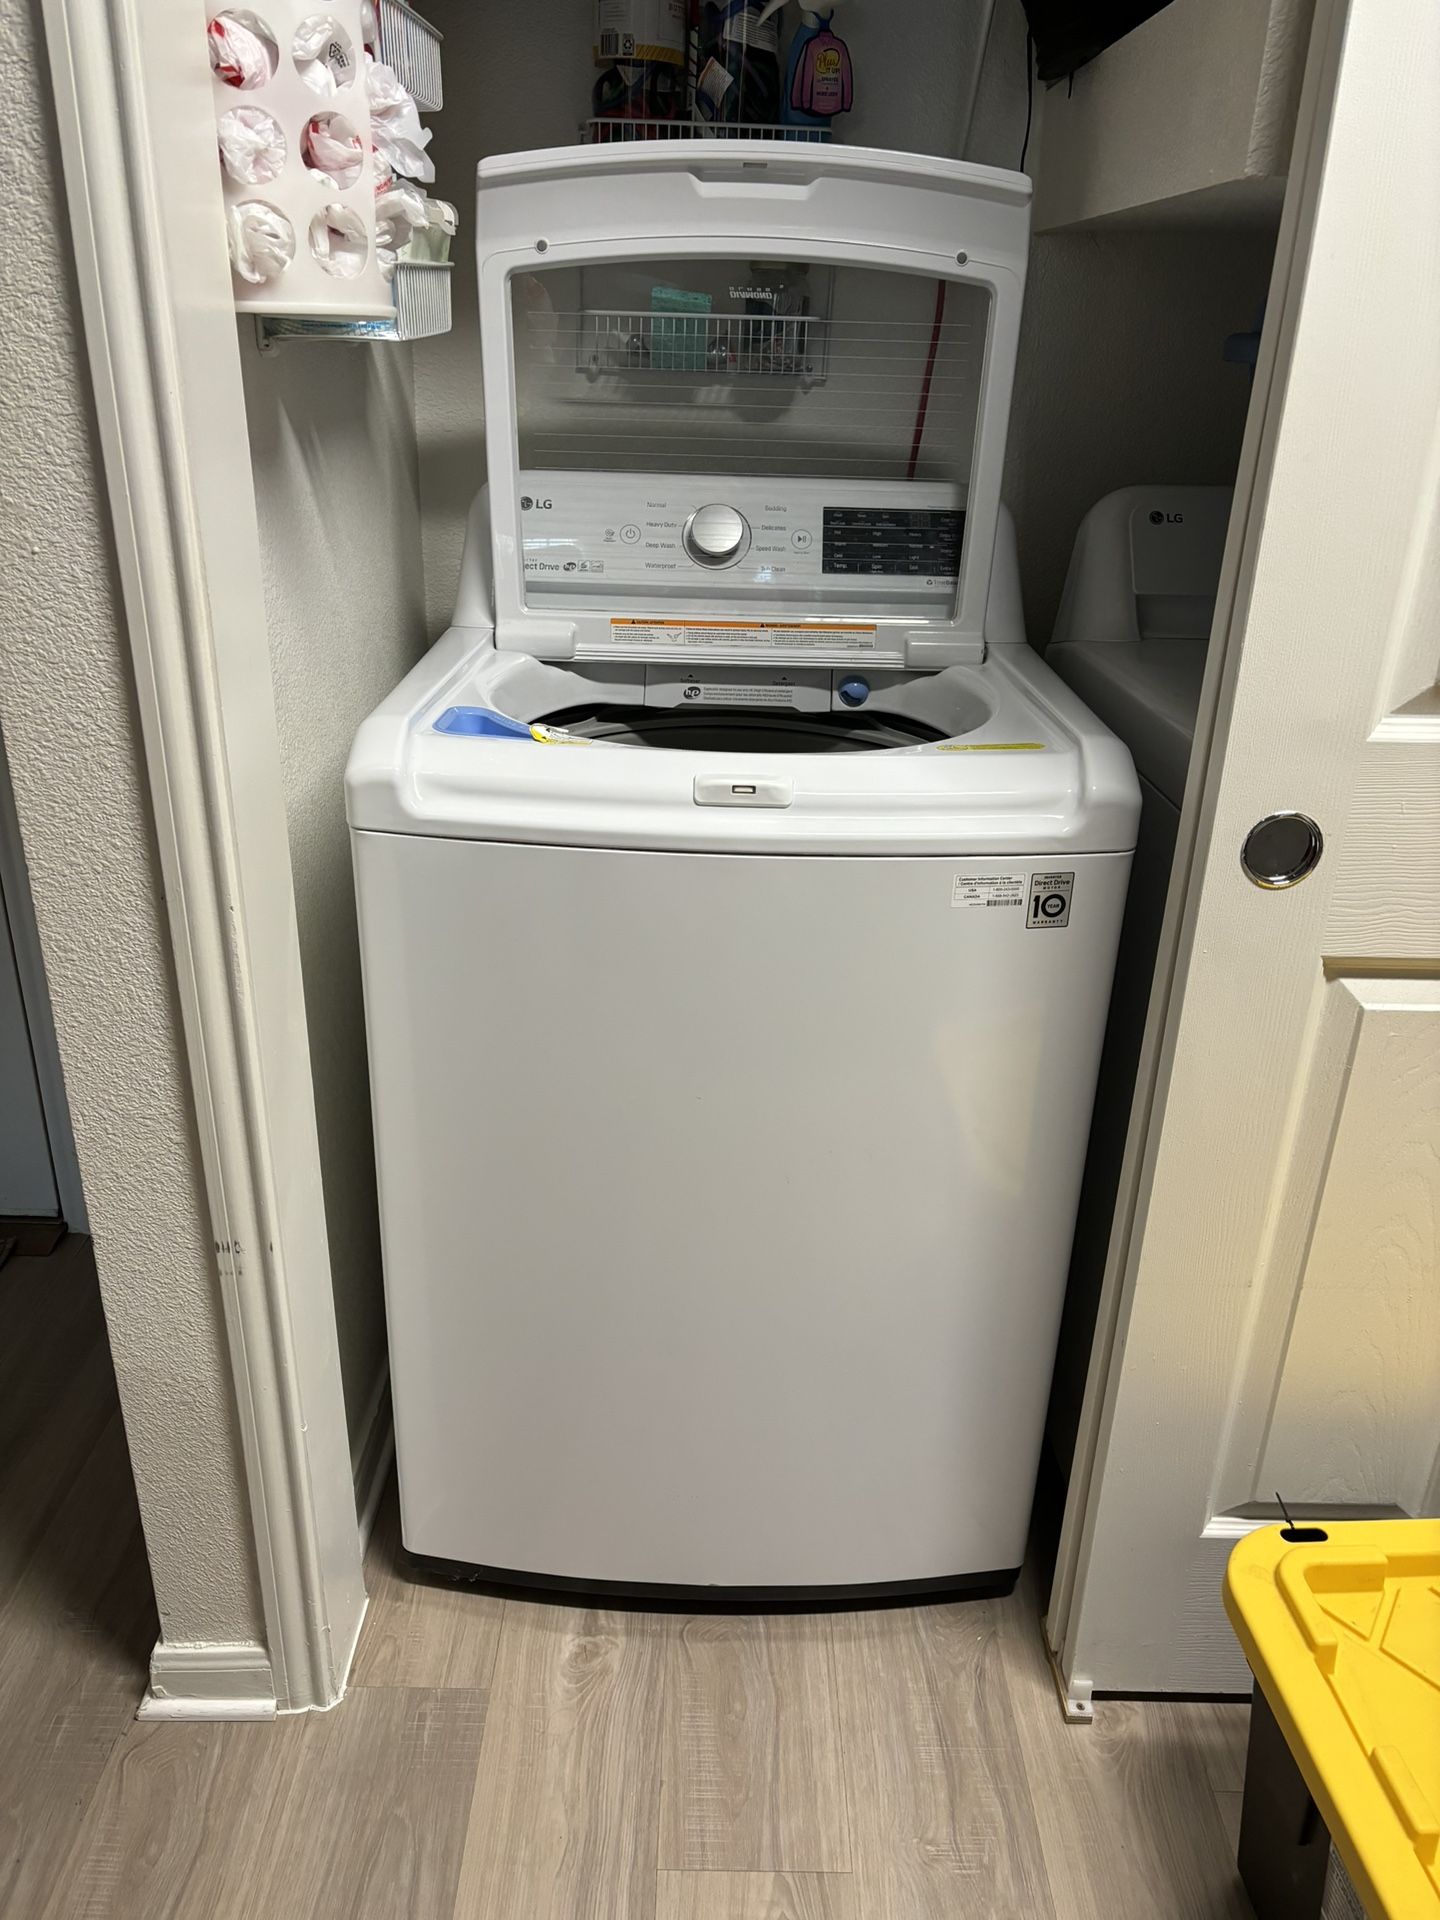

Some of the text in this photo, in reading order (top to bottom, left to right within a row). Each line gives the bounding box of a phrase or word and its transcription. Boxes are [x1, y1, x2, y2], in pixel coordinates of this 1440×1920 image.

[535, 498, 553, 510] LG
[764, 504, 787, 512] Bedding
[1166, 513, 1184, 524] LG
[646, 521, 664, 529] Heavy
[538, 562, 560, 571] Drive
[1033, 893, 1066, 918] 10
